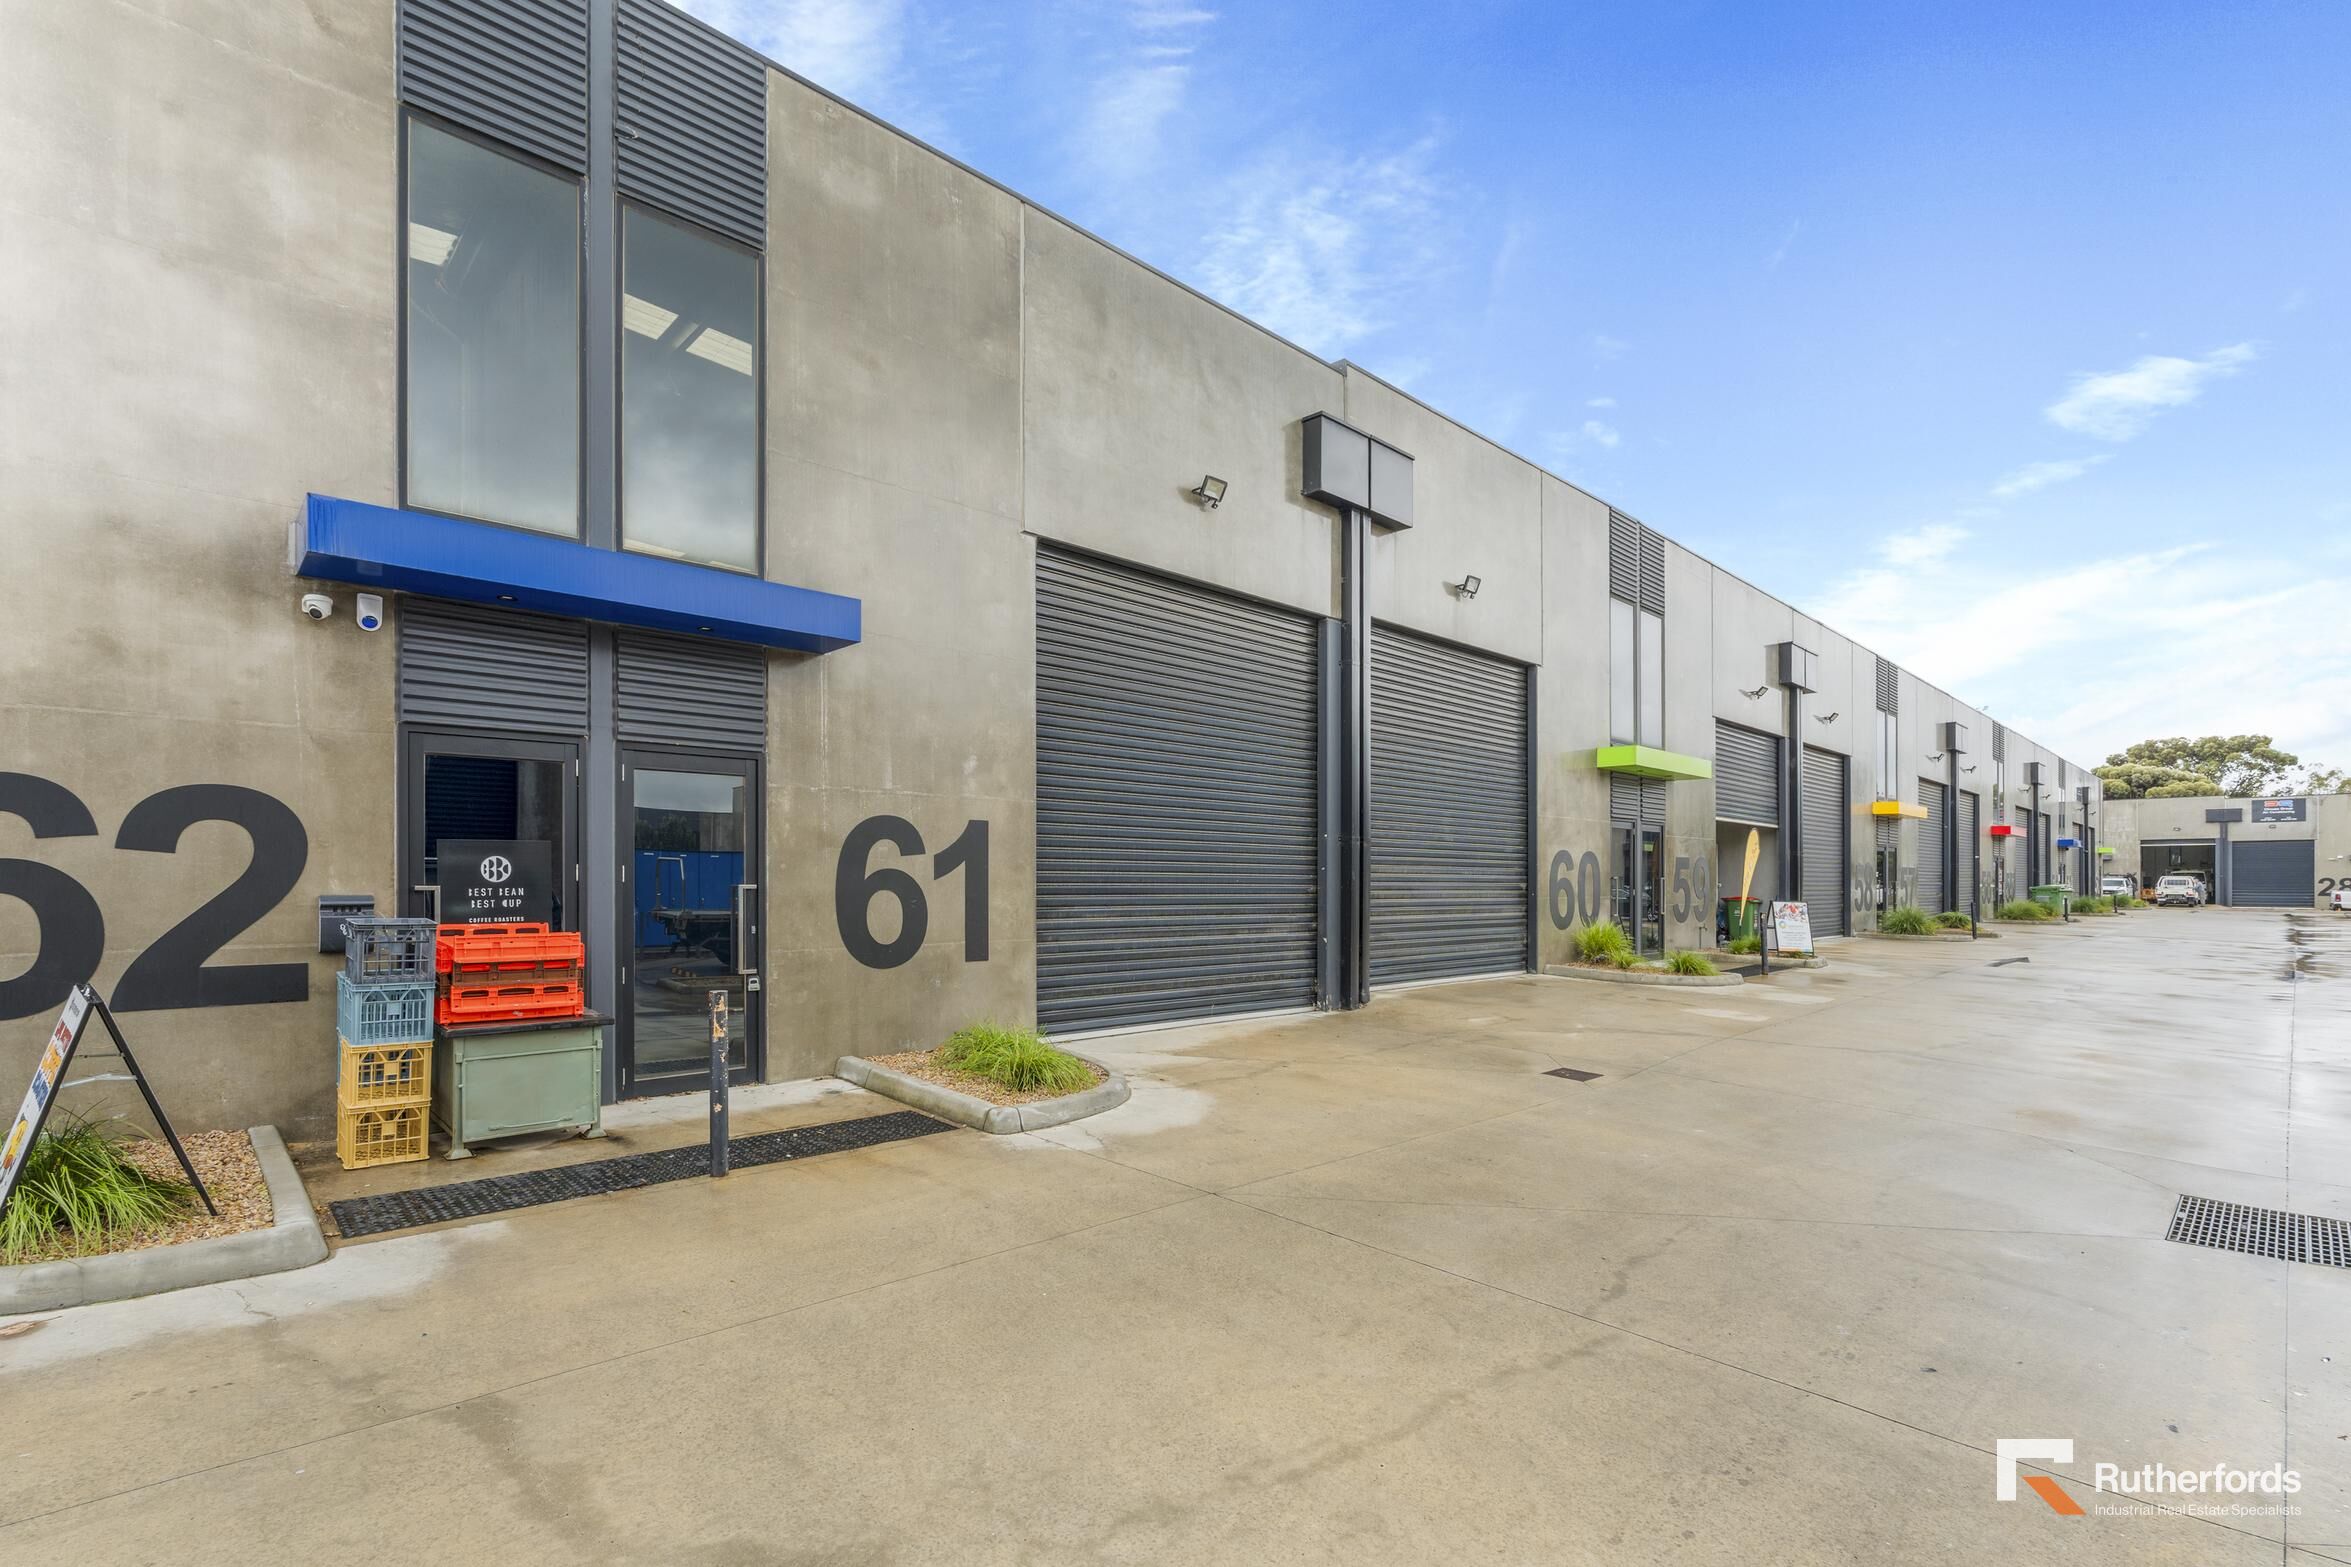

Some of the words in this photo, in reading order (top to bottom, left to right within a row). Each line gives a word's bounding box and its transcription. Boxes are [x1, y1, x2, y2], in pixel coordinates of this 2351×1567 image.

[468, 888, 493, 897] BEST
[499, 888, 524, 896] BEAN
[471, 900, 496, 908] BEST
[502, 899, 522, 908] CUP
[835, 815, 989, 970] 61
[1549, 850, 1601, 931] 60
[1672, 857, 1710, 924] 59
